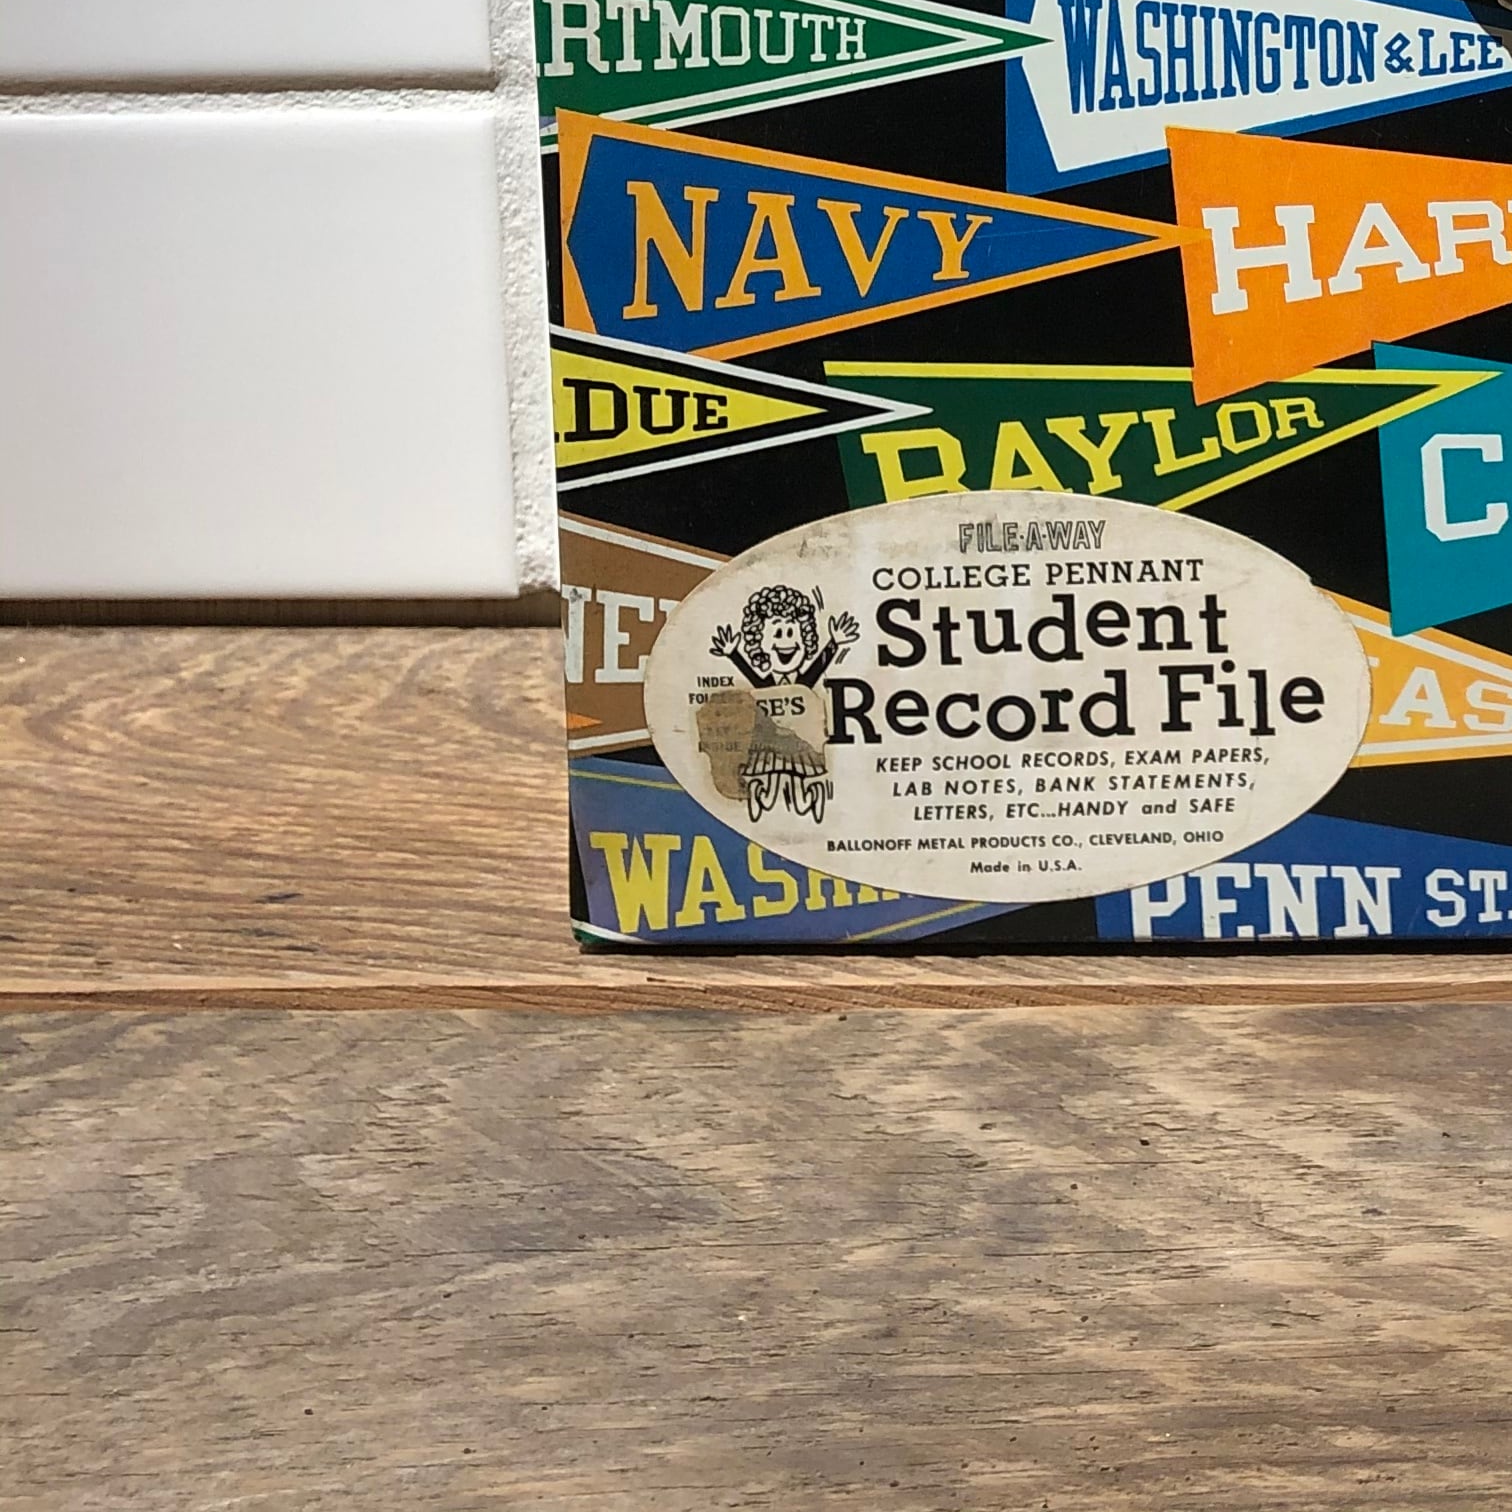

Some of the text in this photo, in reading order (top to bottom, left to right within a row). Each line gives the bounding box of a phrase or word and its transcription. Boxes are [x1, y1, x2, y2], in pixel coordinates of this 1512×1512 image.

[623, 180, 993, 320] NAVY
[554, 377, 728, 444] DUE
[872, 558, 1205, 591] COLLEGE PENNANT
[875, 593, 1229, 668] Student
[697, 676, 735, 688] INDEX
[824, 659, 1325, 745] Record File
[876, 747, 1269, 773] KEEP SCHOOL RECORDS, EXAM PAPERS,
[893, 772, 1255, 797] LAB NOTES, BANK STATEMENTS,
[914, 805, 994, 821] LETTERS,
[1141, 799, 1177, 814] and
[1189, 798, 1236, 813] SAFE
[827, 830, 1224, 852] BALLONOFF METAL PRODUCTS CO., CLEVELAND, OHIO
[970, 859, 1082, 873] Made in U.S.A.
[1130, 862, 1402, 940] PENN
